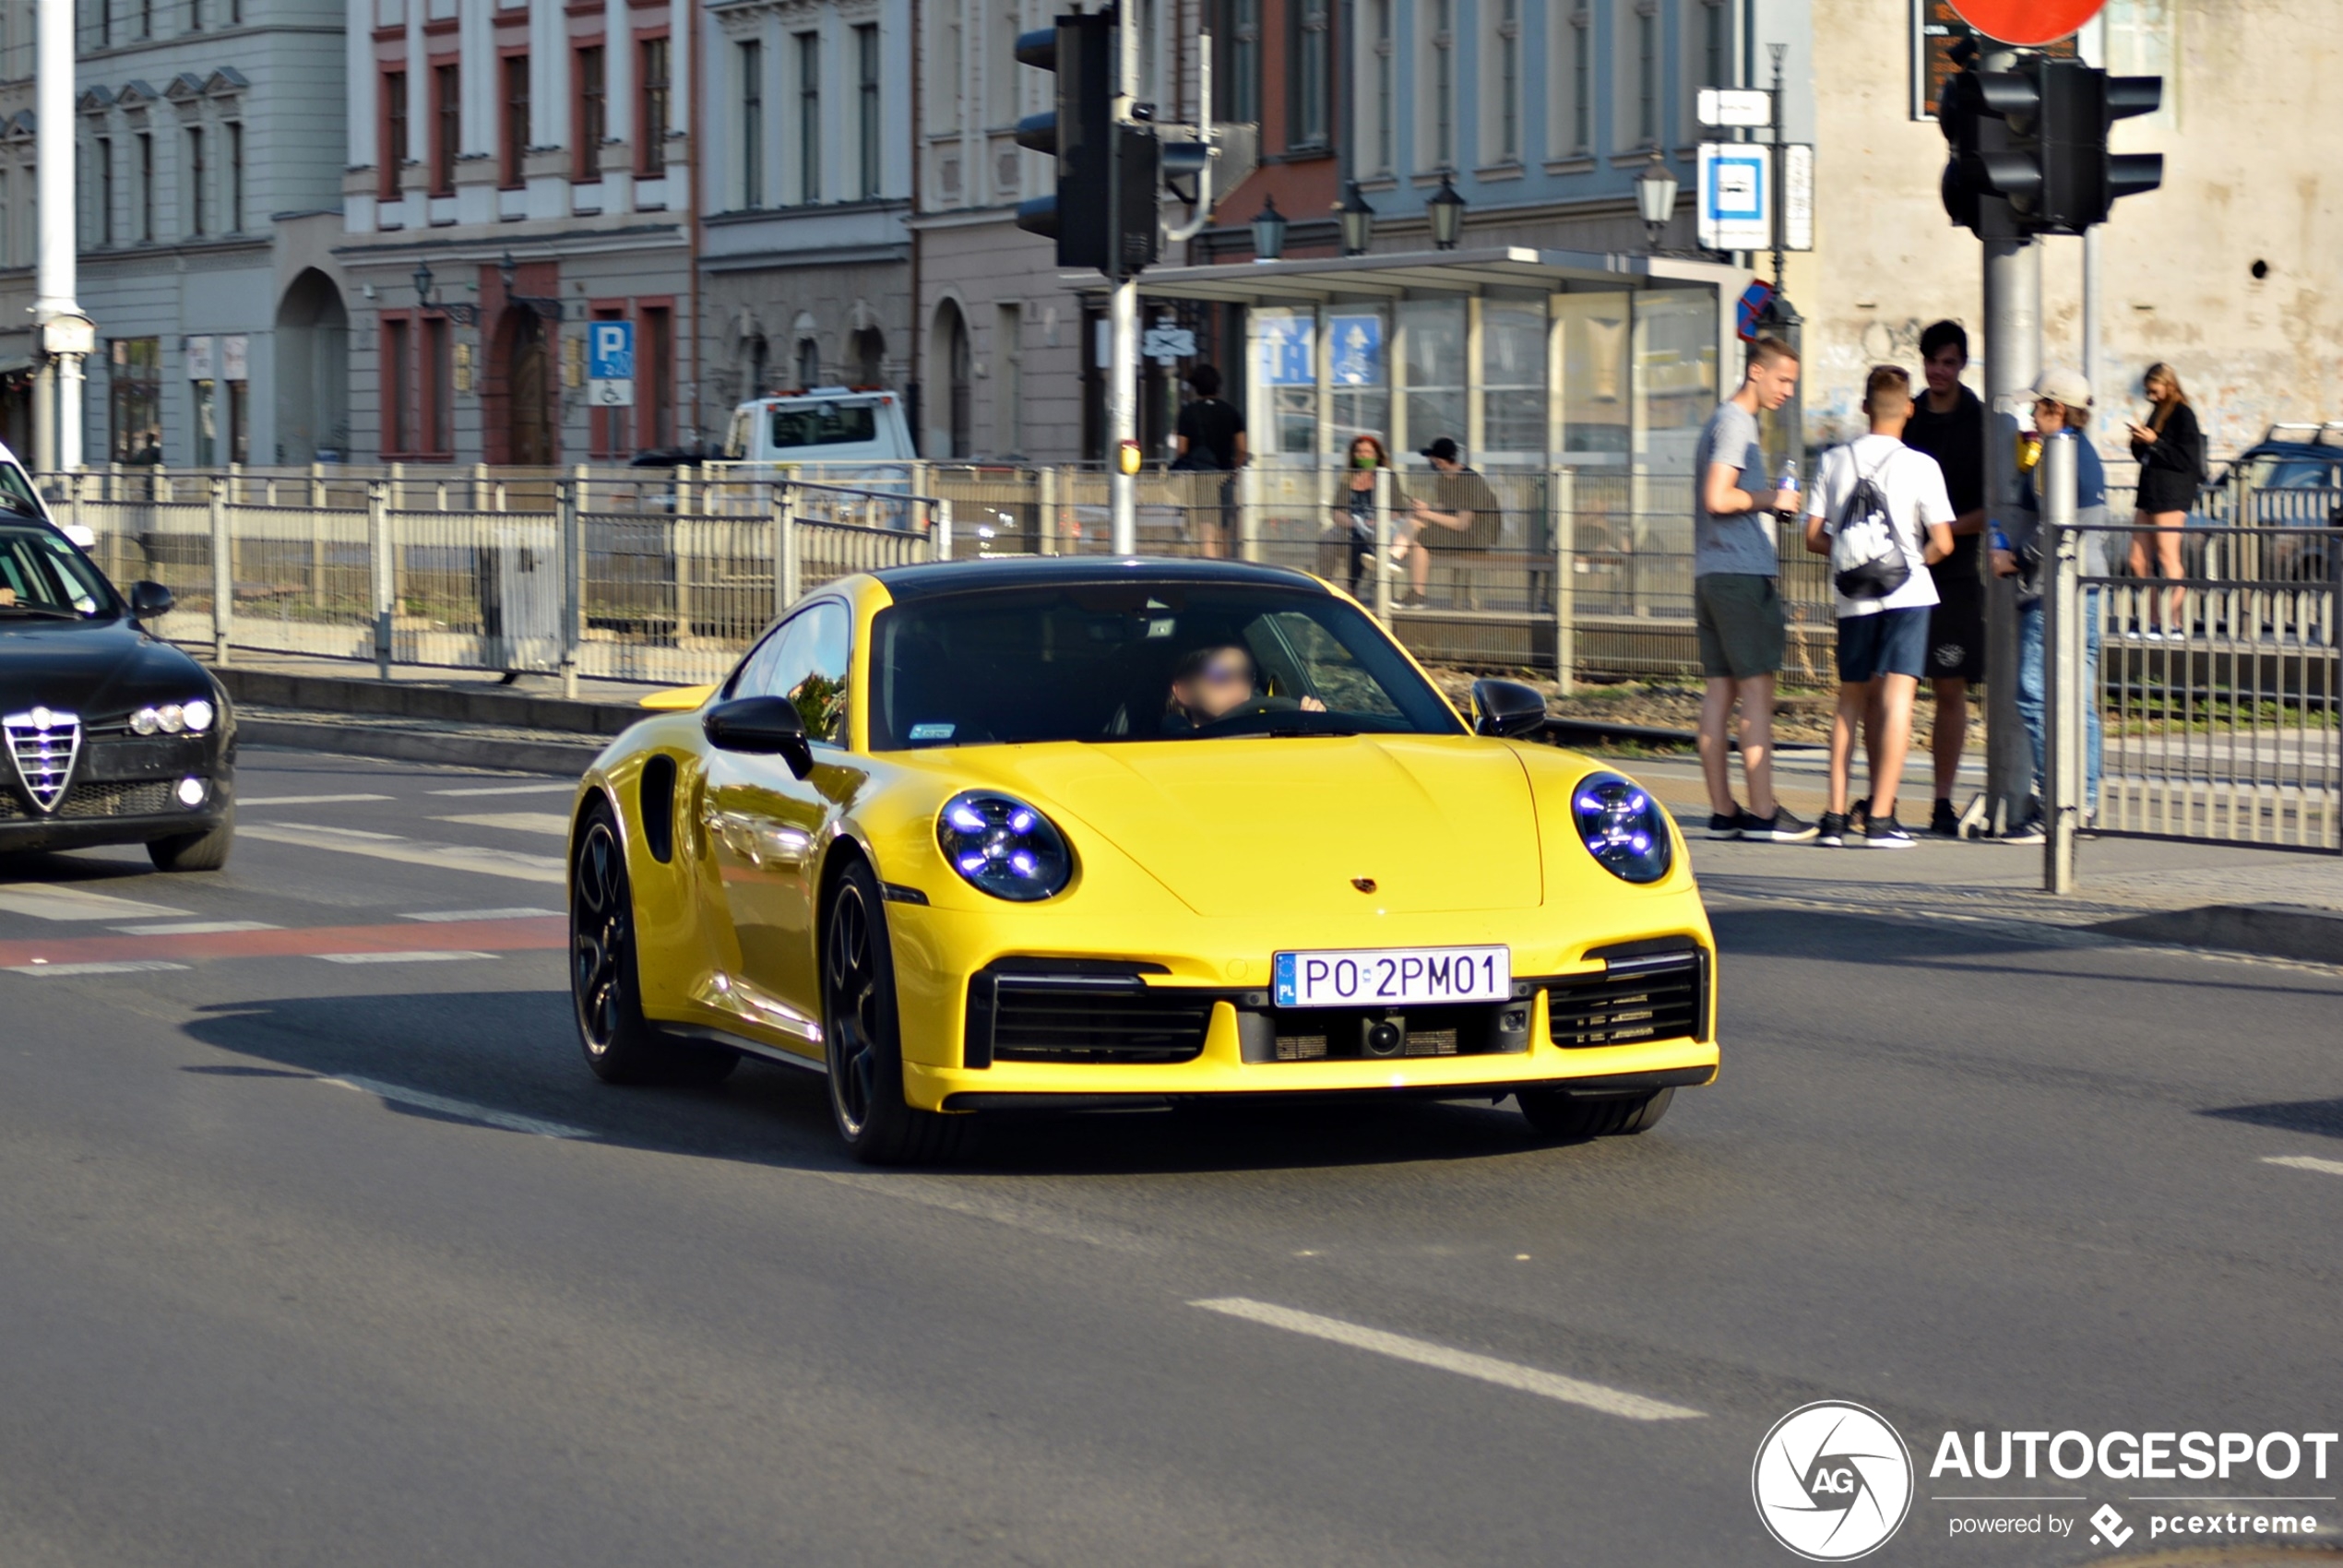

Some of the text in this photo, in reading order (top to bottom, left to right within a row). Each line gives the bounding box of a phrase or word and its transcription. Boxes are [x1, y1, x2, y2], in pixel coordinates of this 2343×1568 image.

[597, 326, 625, 362] P
[1279, 984, 1295, 998] PL
[1306, 955, 1494, 998] PO 2PM01
